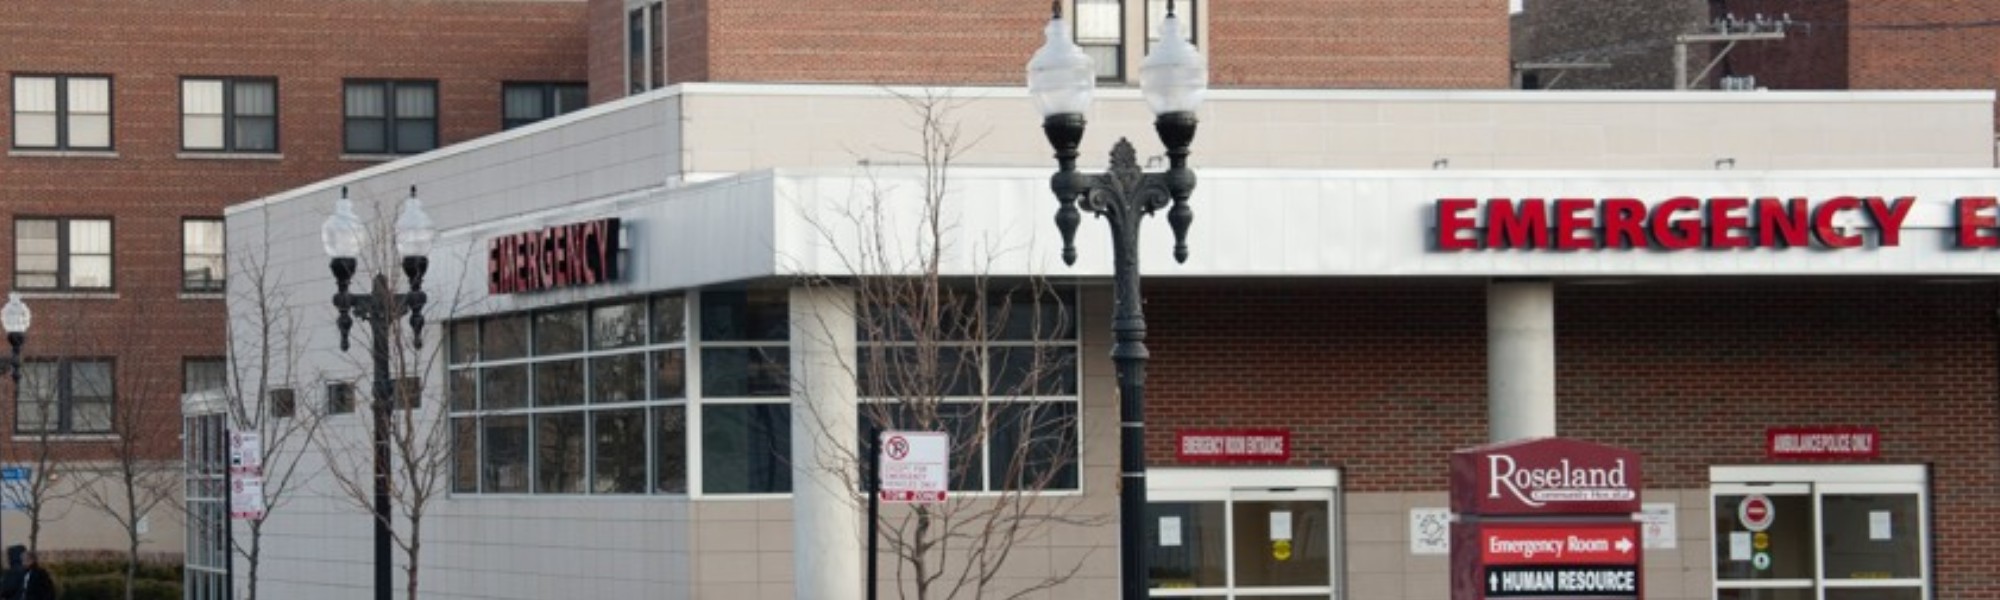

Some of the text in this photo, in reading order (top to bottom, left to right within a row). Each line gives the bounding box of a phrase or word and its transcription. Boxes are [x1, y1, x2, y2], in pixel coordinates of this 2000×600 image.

[1435, 196, 1916, 249] EMERGENCY
[488, 218, 611, 294] EMERGENCY
[1182, 435, 1283, 456] EMERGENCY ROOM ENTRANCE
[1851, 433, 1872, 453] ONLY
[1487, 454, 1626, 506] Roseland
[1489, 535, 1609, 558] Emergency Room
[1502, 570, 1635, 592] HUMAN RESOURCE
